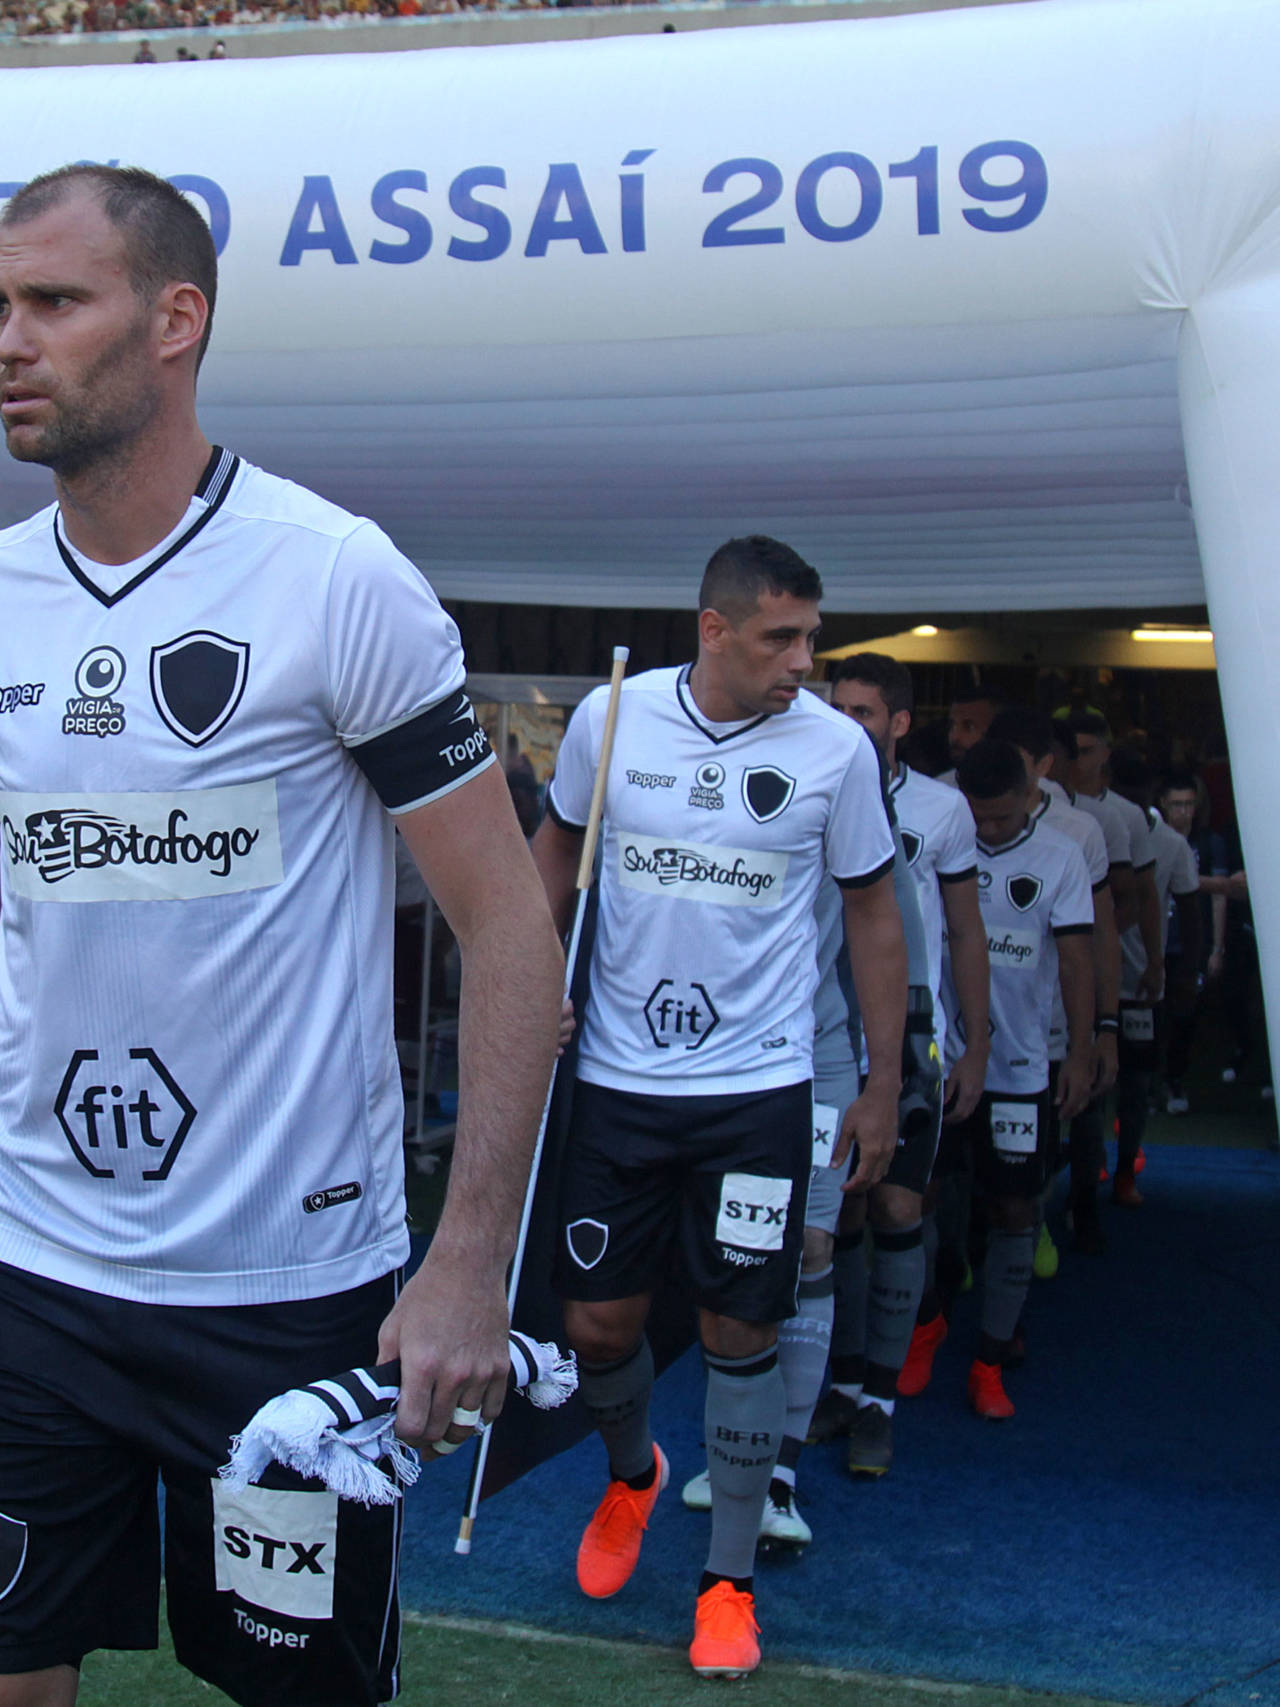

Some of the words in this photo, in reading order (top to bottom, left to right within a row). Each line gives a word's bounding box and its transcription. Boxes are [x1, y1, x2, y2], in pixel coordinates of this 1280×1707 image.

[280, 148, 658, 266] ASSAÍ
[701, 139, 1049, 249] 2019
[68, 700, 113, 715] VIGIA
[64, 717, 122, 736] PREÇO
[439, 726, 488, 767] Toppe
[626, 770, 676, 789] Topper
[3, 814, 43, 865] Sou
[63, 808, 260, 877] Botafogo
[623, 845, 661, 875] Sou
[677, 855, 777, 897] Botafogo
[988, 934, 1033, 962] tafogo
[655, 997, 702, 1035] fit
[74, 1084, 166, 1150] fit
[994, 1119, 1035, 1137] STX
[326, 1185, 355, 1200] Topper
[725, 1199, 785, 1226] STX
[721, 1246, 769, 1268] Topper
[716, 1425, 771, 1447] BFR
[222, 1524, 328, 1576] STX
[232, 1607, 311, 1649] Topper
